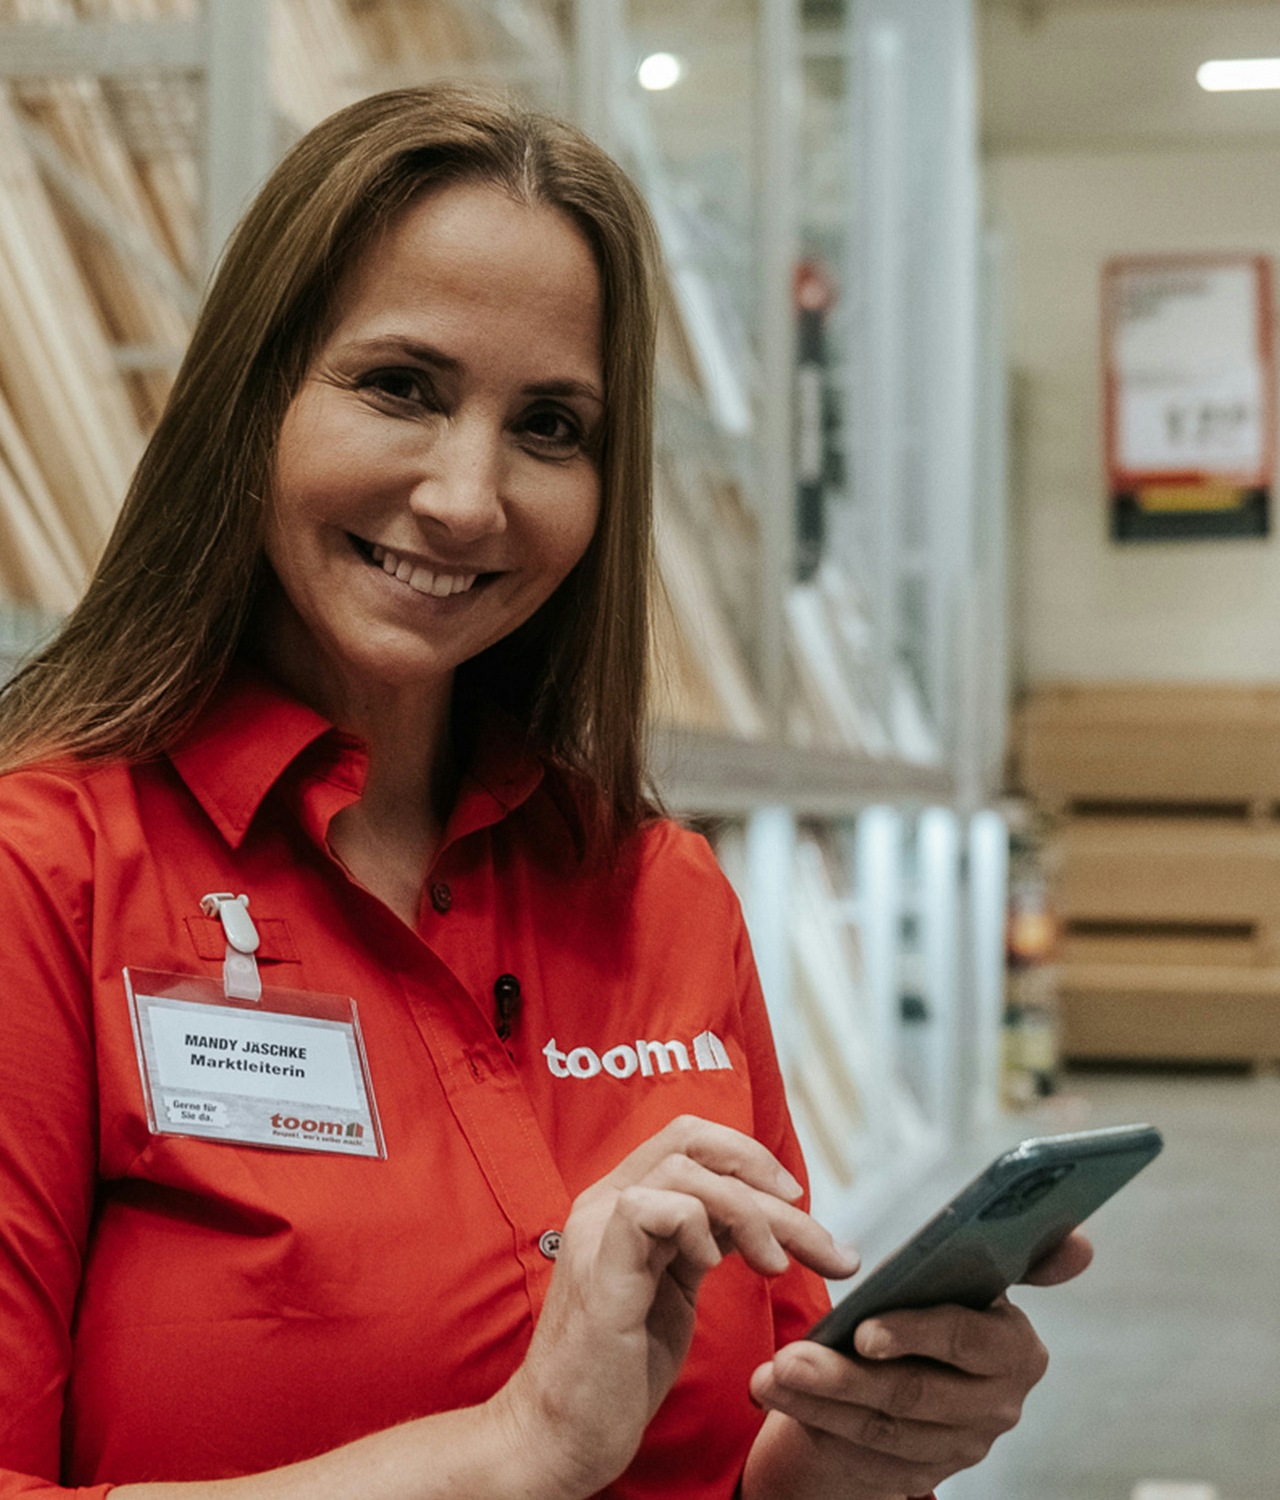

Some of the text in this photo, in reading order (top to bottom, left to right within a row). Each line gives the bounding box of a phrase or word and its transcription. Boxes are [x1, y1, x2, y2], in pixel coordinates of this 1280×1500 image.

[185, 1034, 307, 1060] MANDY JÄSCHKE
[542, 1037, 692, 1079] toom
[190, 1054, 306, 1078] Marktleiterin
[173, 1099, 217, 1112] Gerne für
[181, 1110, 196, 1120] Sie
[270, 1113, 342, 1136] toom
